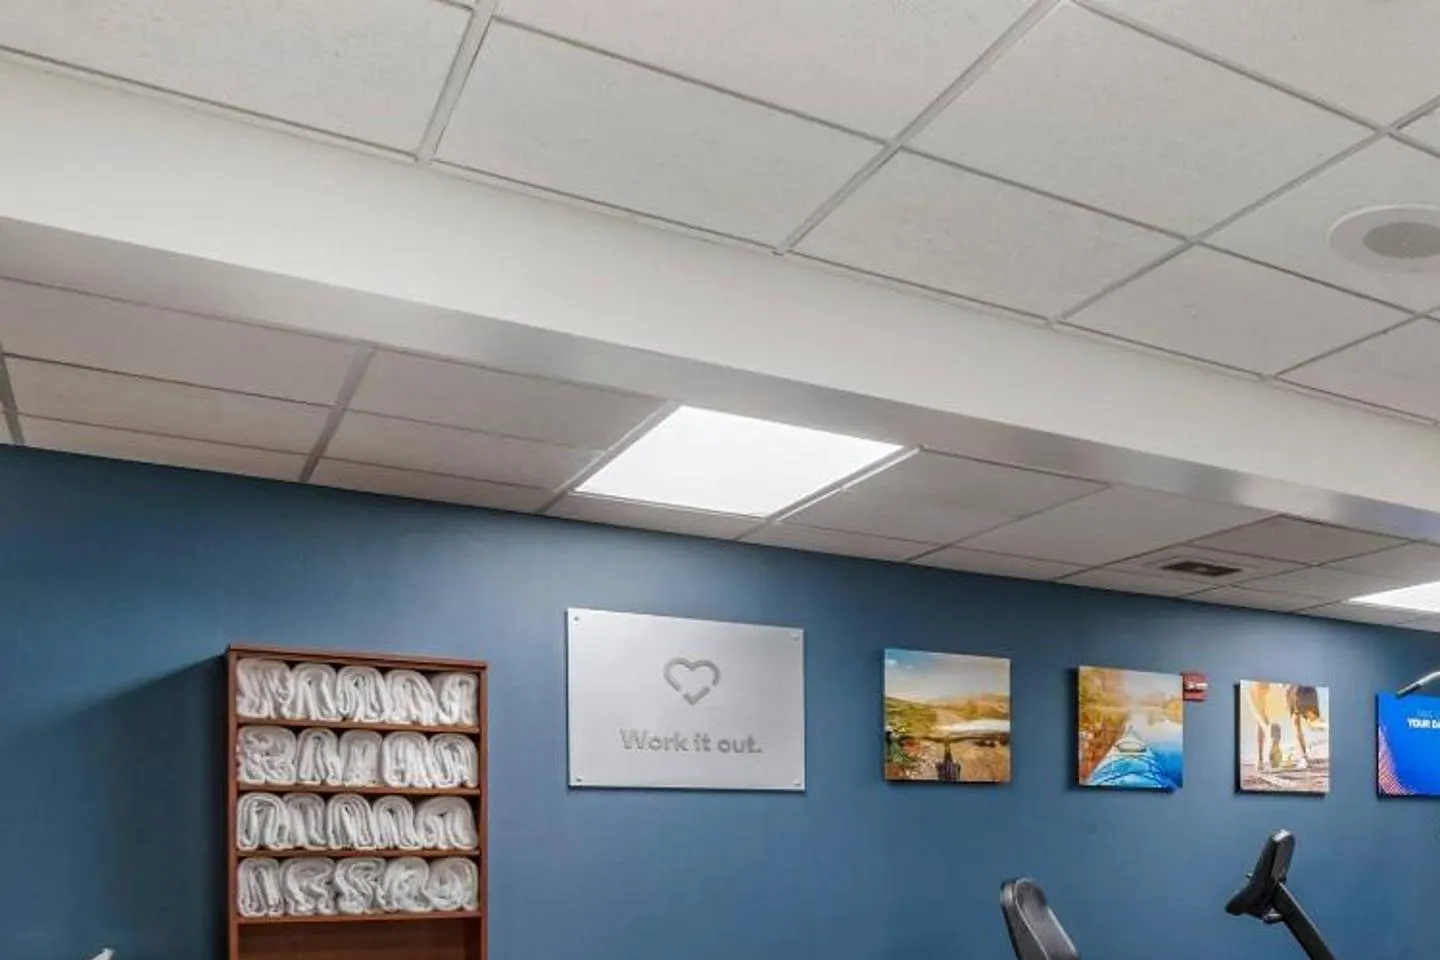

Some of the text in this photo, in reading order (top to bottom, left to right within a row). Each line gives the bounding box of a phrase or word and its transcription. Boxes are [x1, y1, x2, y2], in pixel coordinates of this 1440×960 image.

[1407, 717, 1431, 729] YOUR
[619, 727, 762, 754] Work it out.
